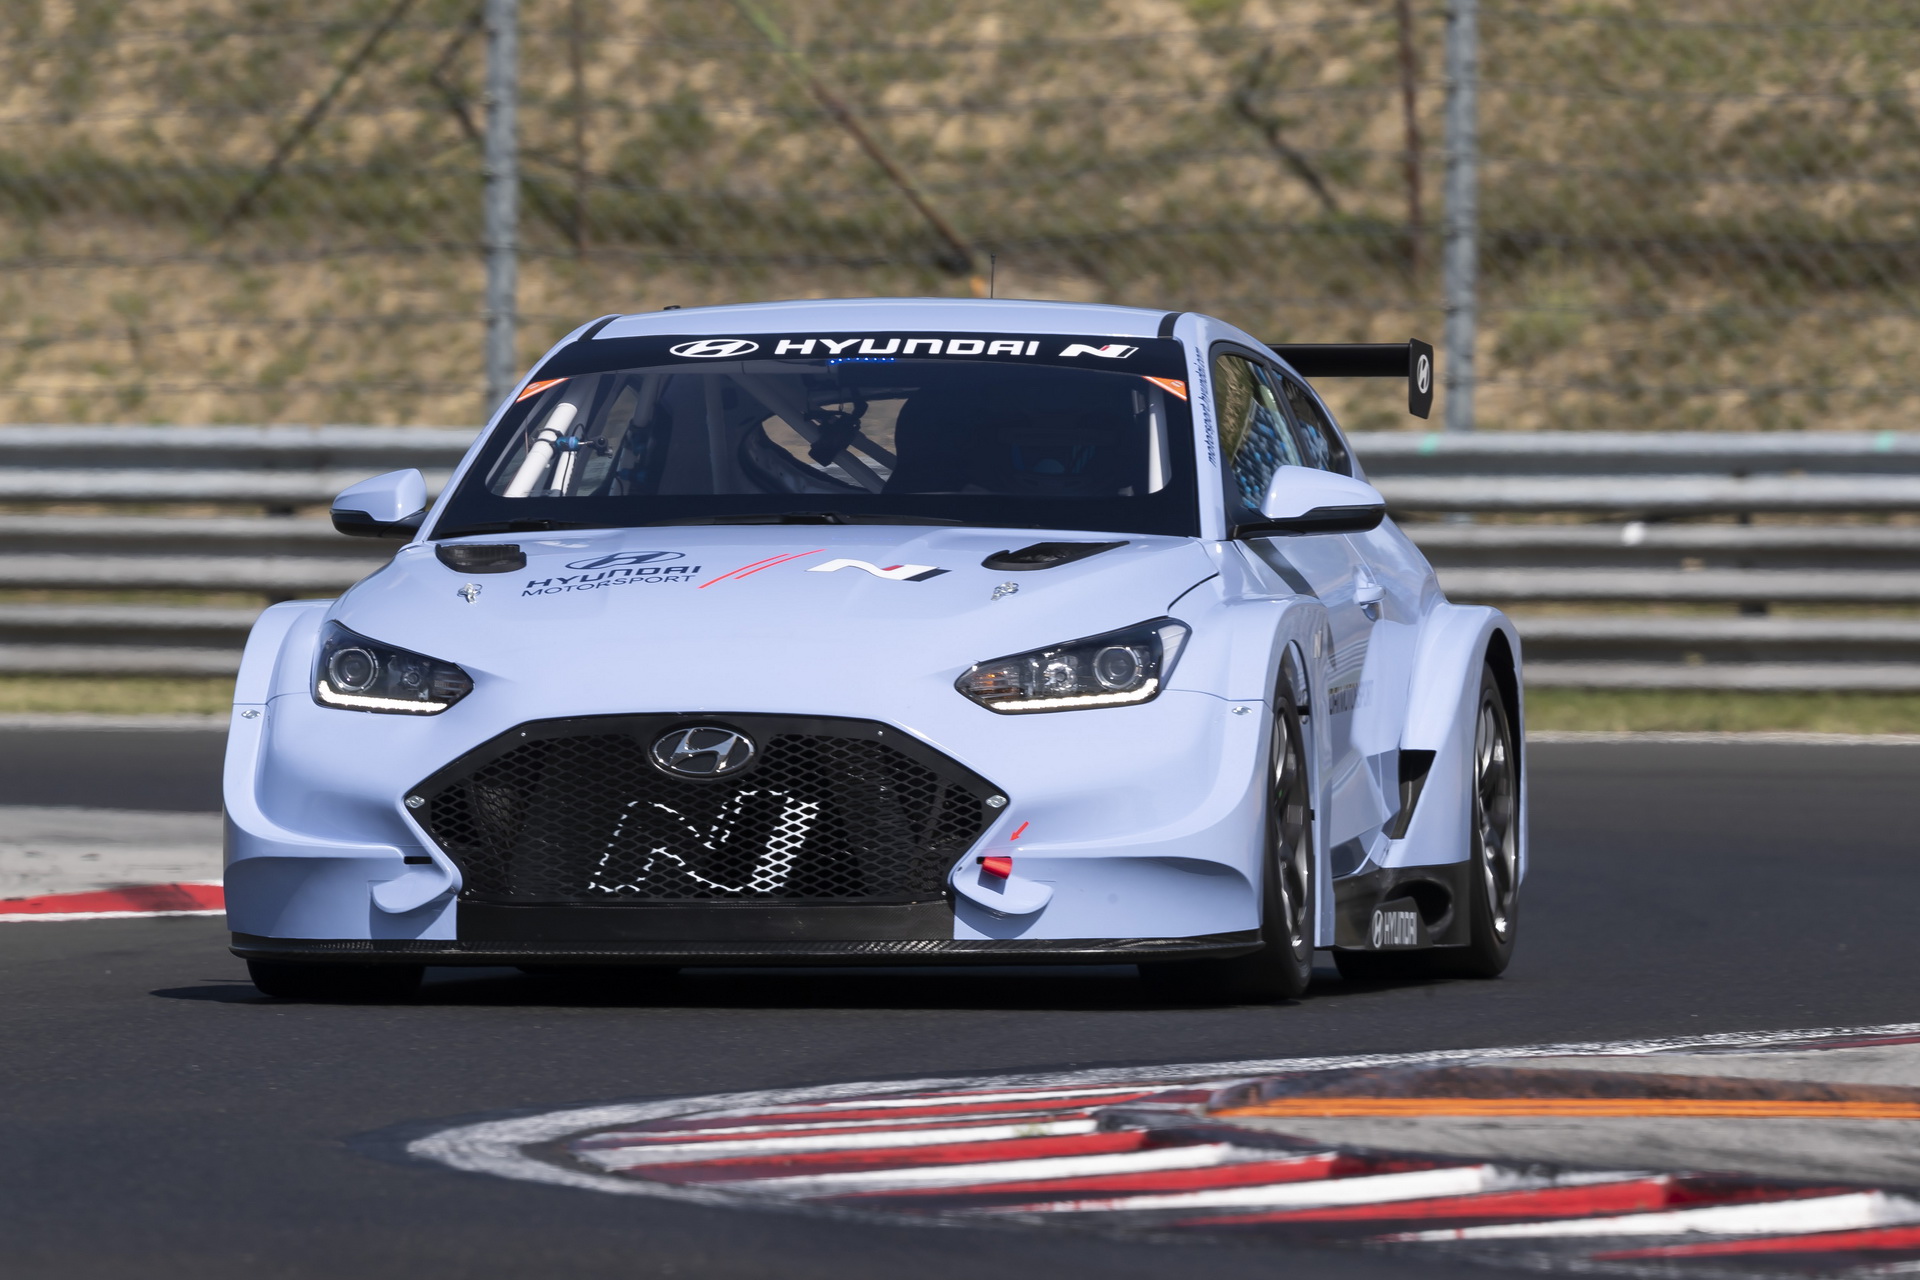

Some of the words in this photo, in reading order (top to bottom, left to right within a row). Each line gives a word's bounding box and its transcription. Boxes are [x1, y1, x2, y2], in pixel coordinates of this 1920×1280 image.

[774, 339, 1040, 355] HYUNDAI
[1058, 344, 1139, 358] N
[521, 575, 696, 597] MOTORSPORT
[526, 566, 702, 588] HYUNDAI
[1384, 911, 1417, 945] HYUNDAI
